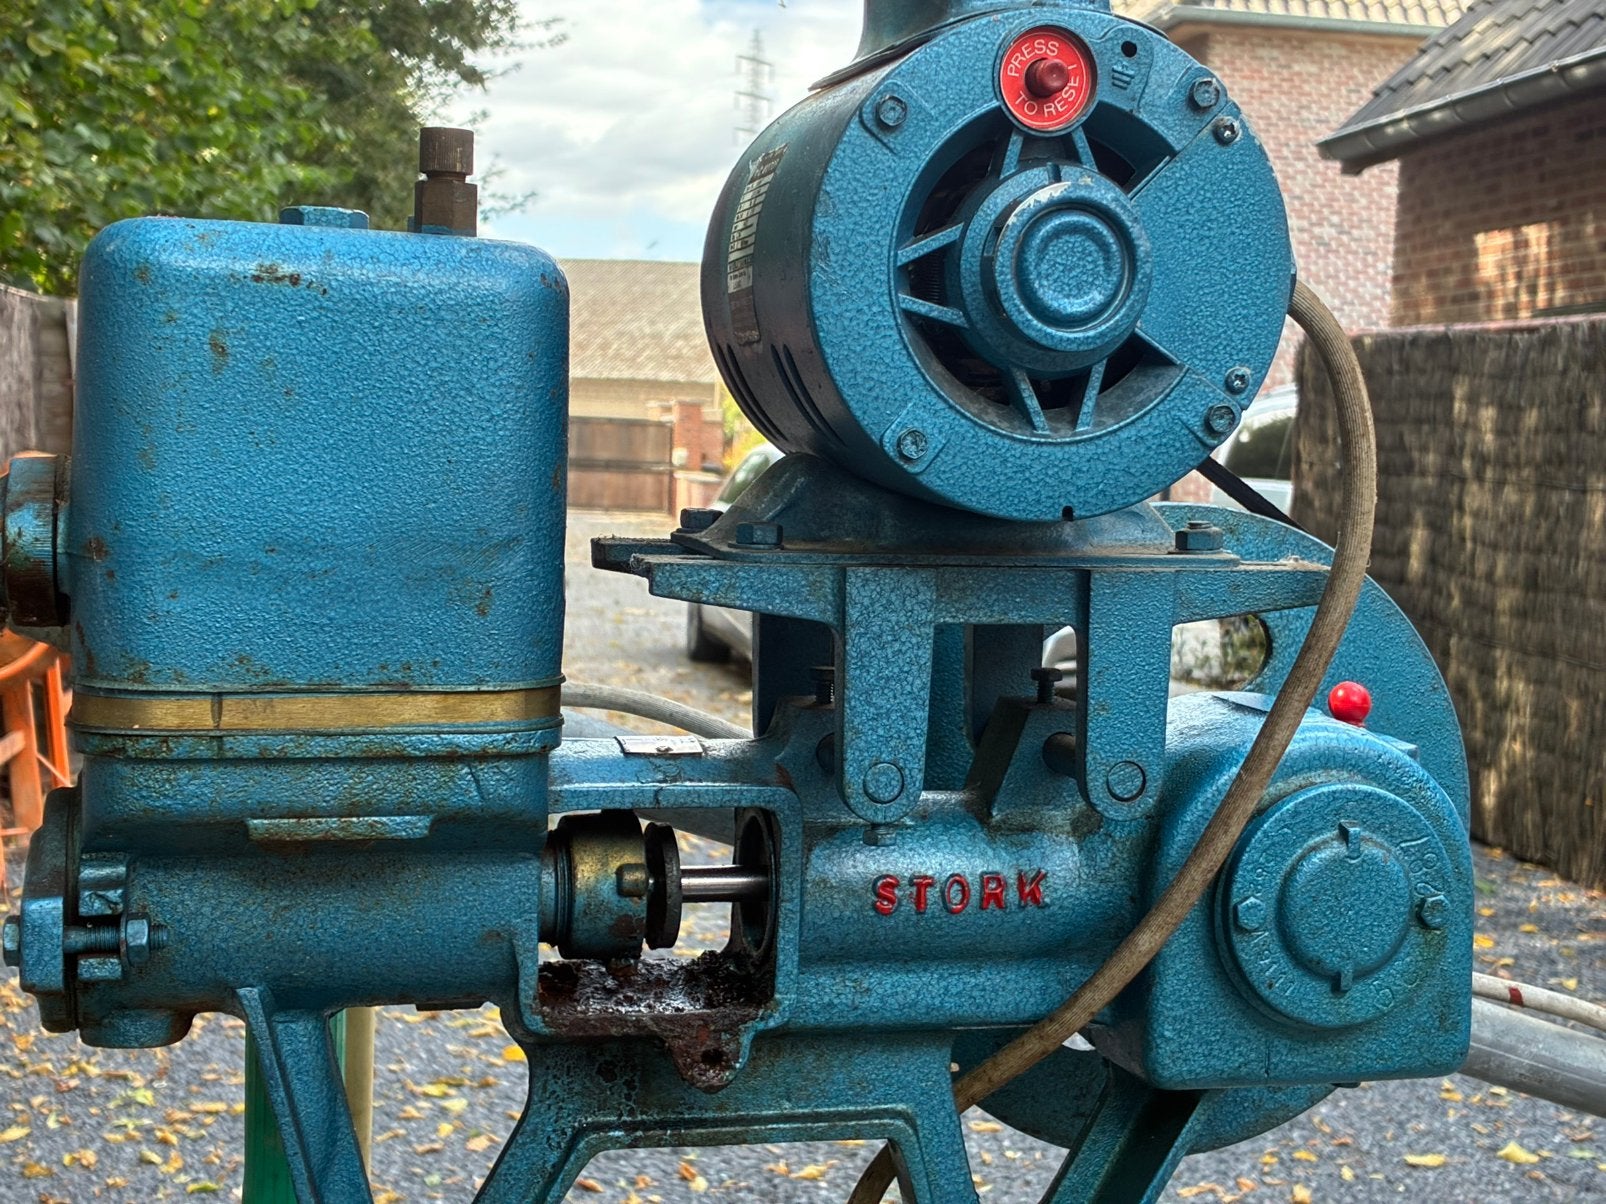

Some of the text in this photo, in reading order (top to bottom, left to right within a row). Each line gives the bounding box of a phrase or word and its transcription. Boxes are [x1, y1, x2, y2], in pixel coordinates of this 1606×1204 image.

[1007, 39, 1059, 77] PRESS
[1015, 91, 1038, 115] TO
[873, 868, 1047, 916] STORK
